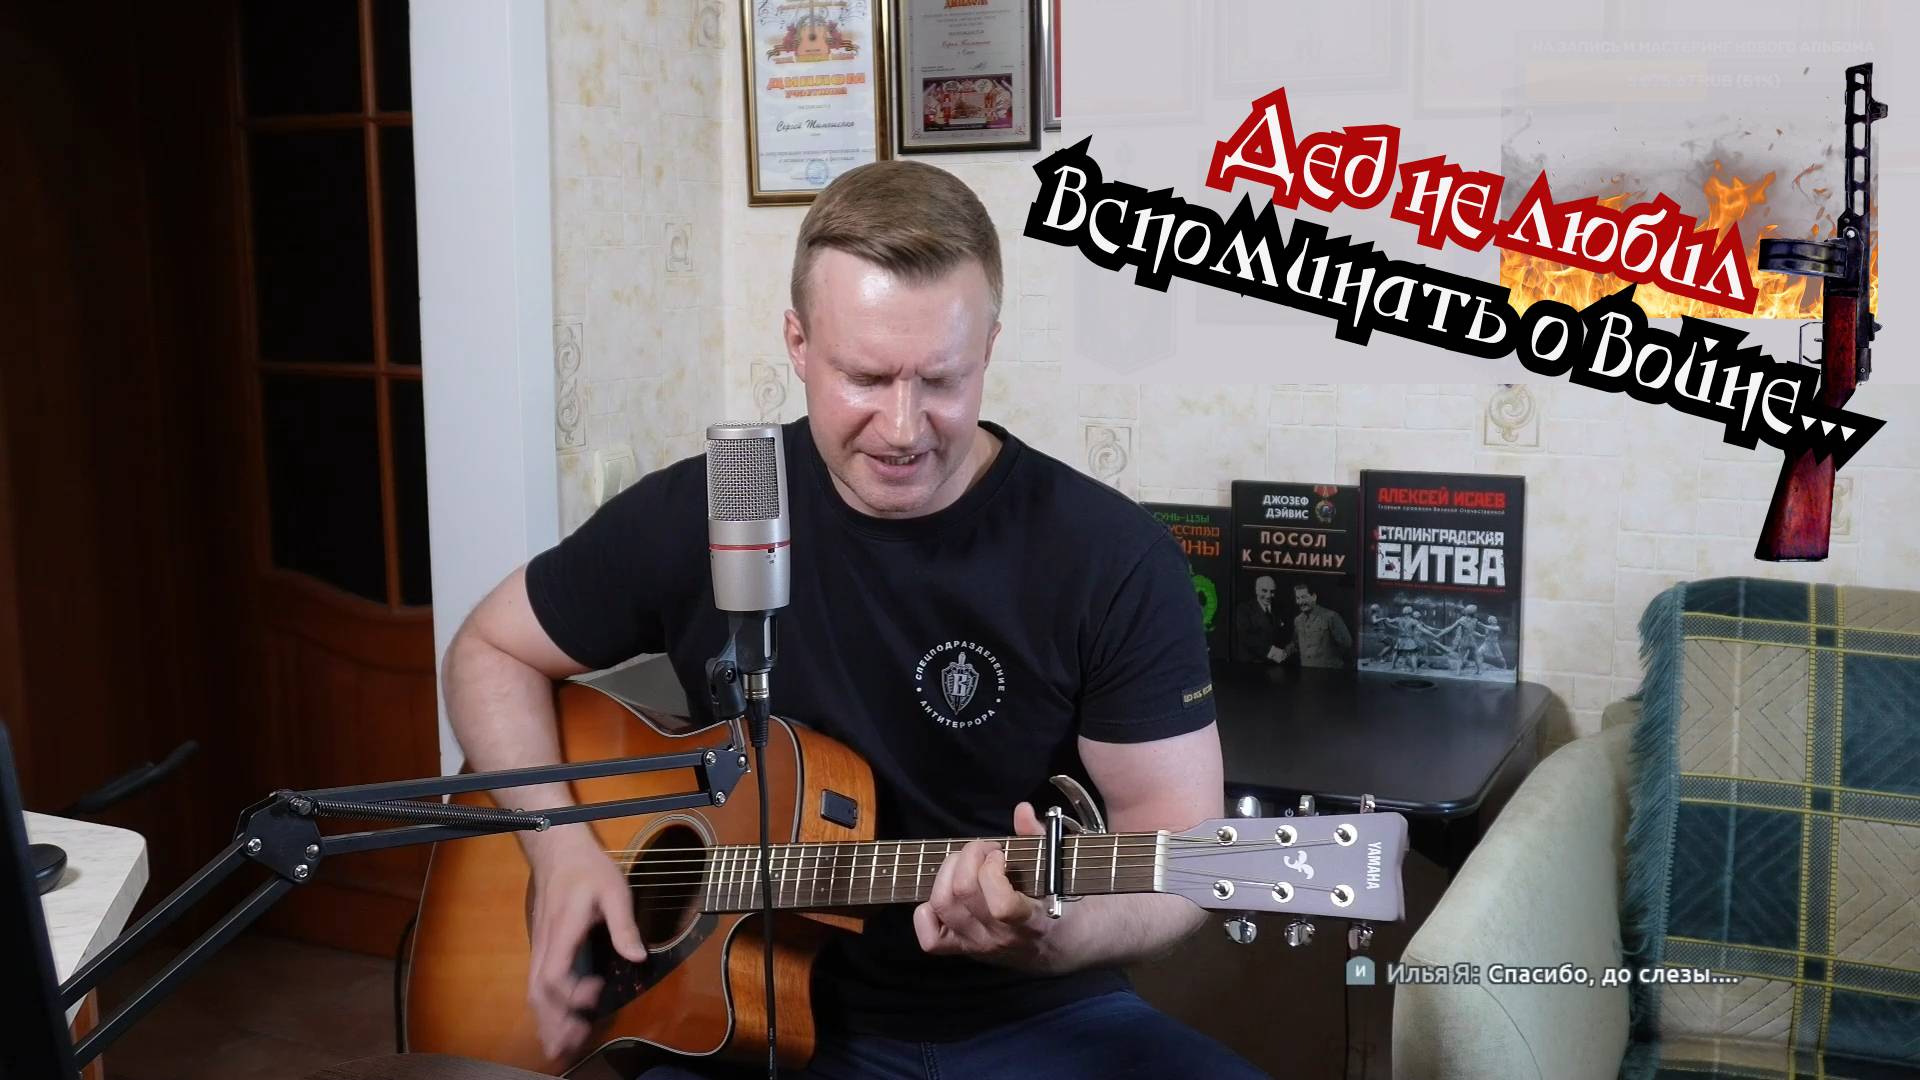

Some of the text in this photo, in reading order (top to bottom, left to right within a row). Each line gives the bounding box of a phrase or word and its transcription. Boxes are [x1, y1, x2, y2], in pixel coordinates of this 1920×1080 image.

[1262, 494, 1309, 506] ДЖОЗЕФ
[1377, 487, 1505, 508] АЛЕКСЕЙ ИСАЕВ
[1265, 507, 1309, 520] ДЭЙВИС
[1260, 530, 1328, 548] ПОСОЛ
[1377, 525, 1505, 546] СТАЛИНГРАДСКАЯ
[1241, 548, 1347, 569] К СТАЛИНУ
[1376, 542, 1506, 587] БИТВА
[914, 640, 1006, 692] СПЕЦПОДРАЗДЕЛЕНИЕ
[919, 699, 996, 729] АНТИТЕРРОРА
[1366, 841, 1383, 891] YAMAHA
